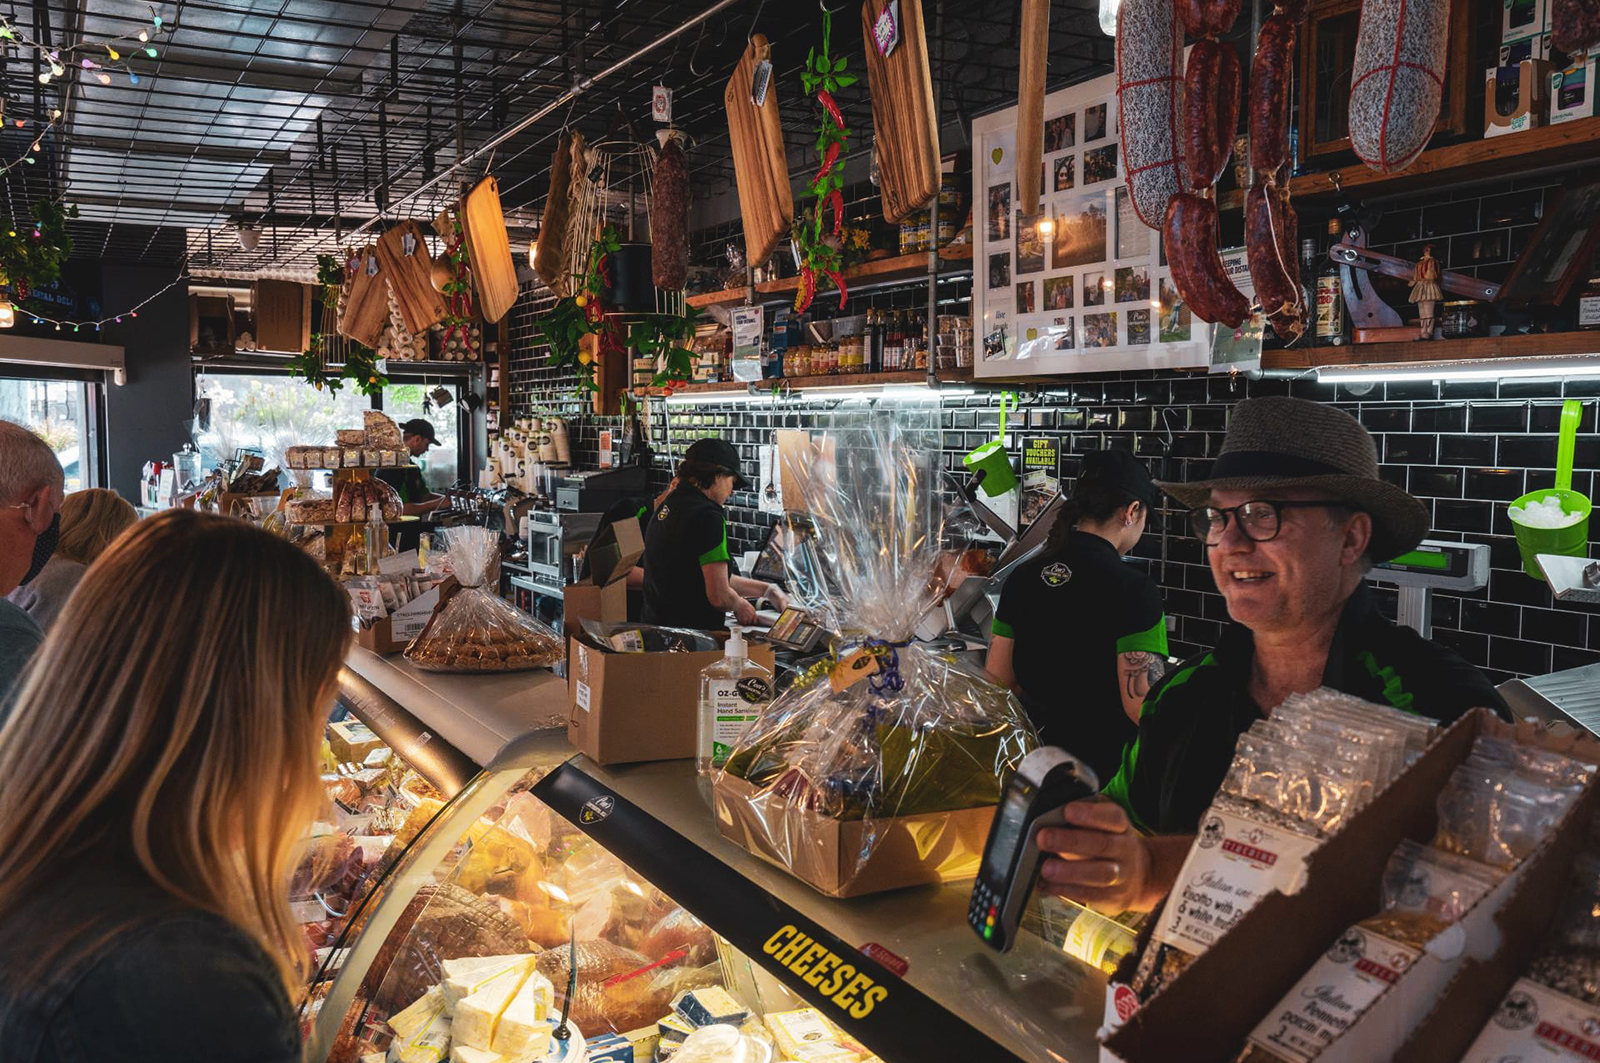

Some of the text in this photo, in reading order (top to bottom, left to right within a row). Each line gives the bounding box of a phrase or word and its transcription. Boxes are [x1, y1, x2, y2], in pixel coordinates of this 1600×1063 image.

[1033, 439, 1048, 449] GIFT
[1026, 448, 1056, 458] VOUCHERS
[1025, 456, 1056, 466] AVAILABLE
[1191, 870, 1234, 893] Italian
[1214, 900, 1234, 915] with
[1189, 908, 1213, 924] white
[762, 924, 889, 1020] CHEESES
